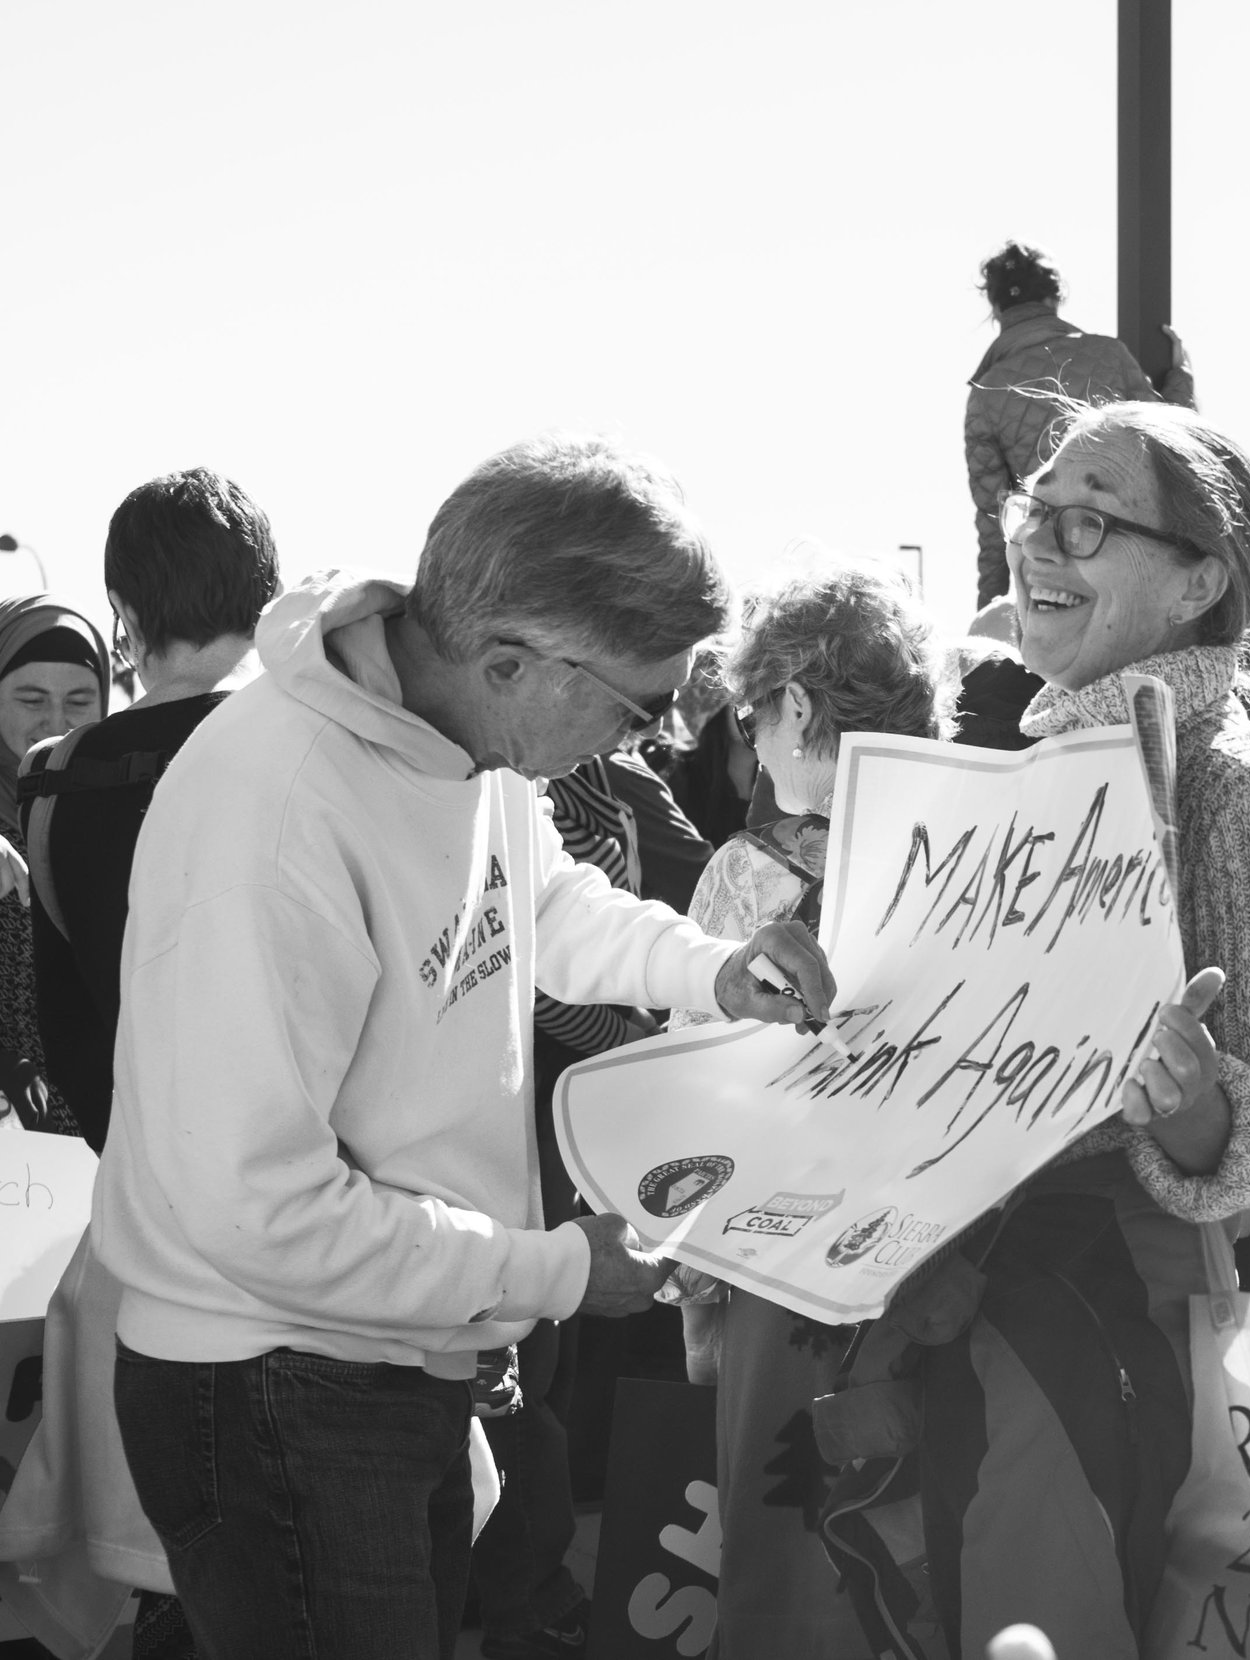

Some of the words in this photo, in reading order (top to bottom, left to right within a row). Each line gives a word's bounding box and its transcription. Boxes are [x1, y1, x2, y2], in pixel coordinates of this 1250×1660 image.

[874, 810, 1055, 951] MAKE
[459, 968, 478, 996] THE
[477, 944, 512, 980] SLOW
[0, 1162, 54, 1210] ch
[766, 1196, 834, 1212] BEYOND
[746, 1216, 793, 1232] COAL
[887, 1213, 948, 1244] SIERRA
